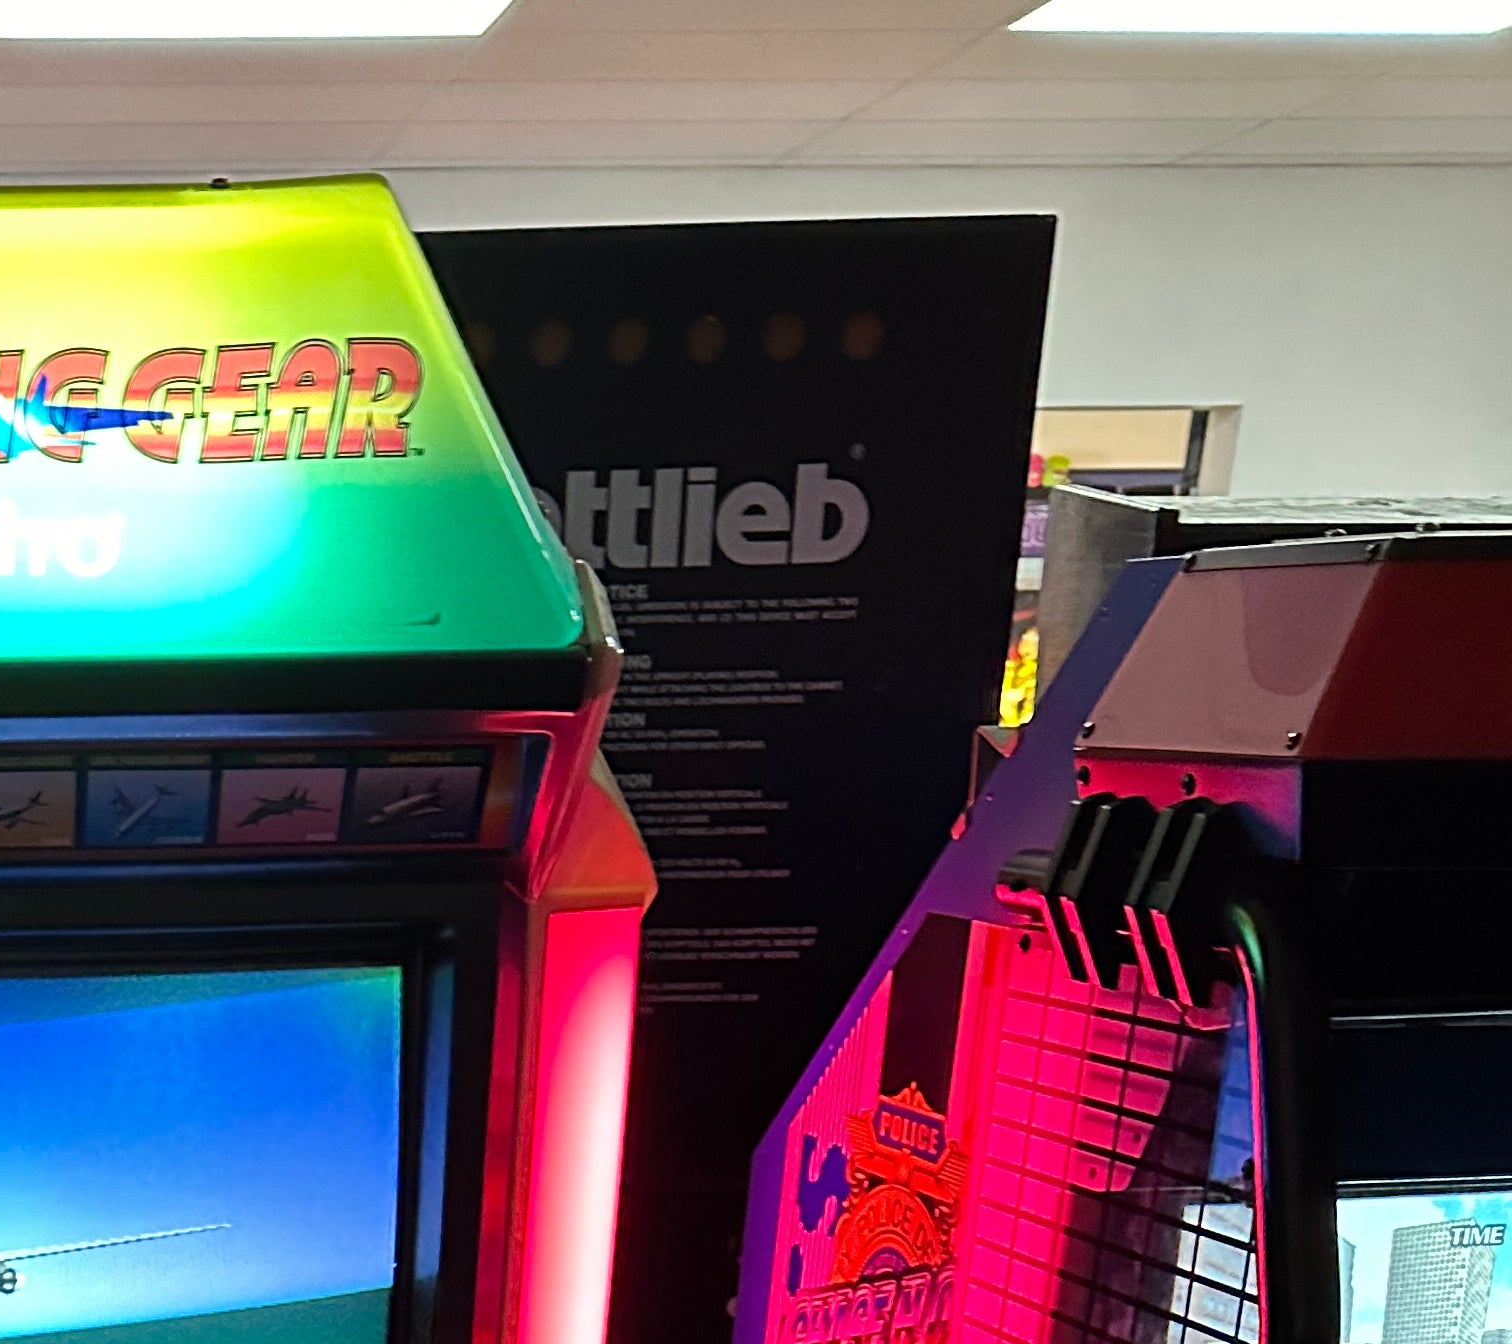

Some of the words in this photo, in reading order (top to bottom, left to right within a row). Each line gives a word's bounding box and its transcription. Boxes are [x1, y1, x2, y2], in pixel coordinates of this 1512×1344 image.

[122, 338, 425, 464] GEAR
[879, 1110, 940, 1155] POLICE
[1450, 1224, 1507, 1247] TIME
